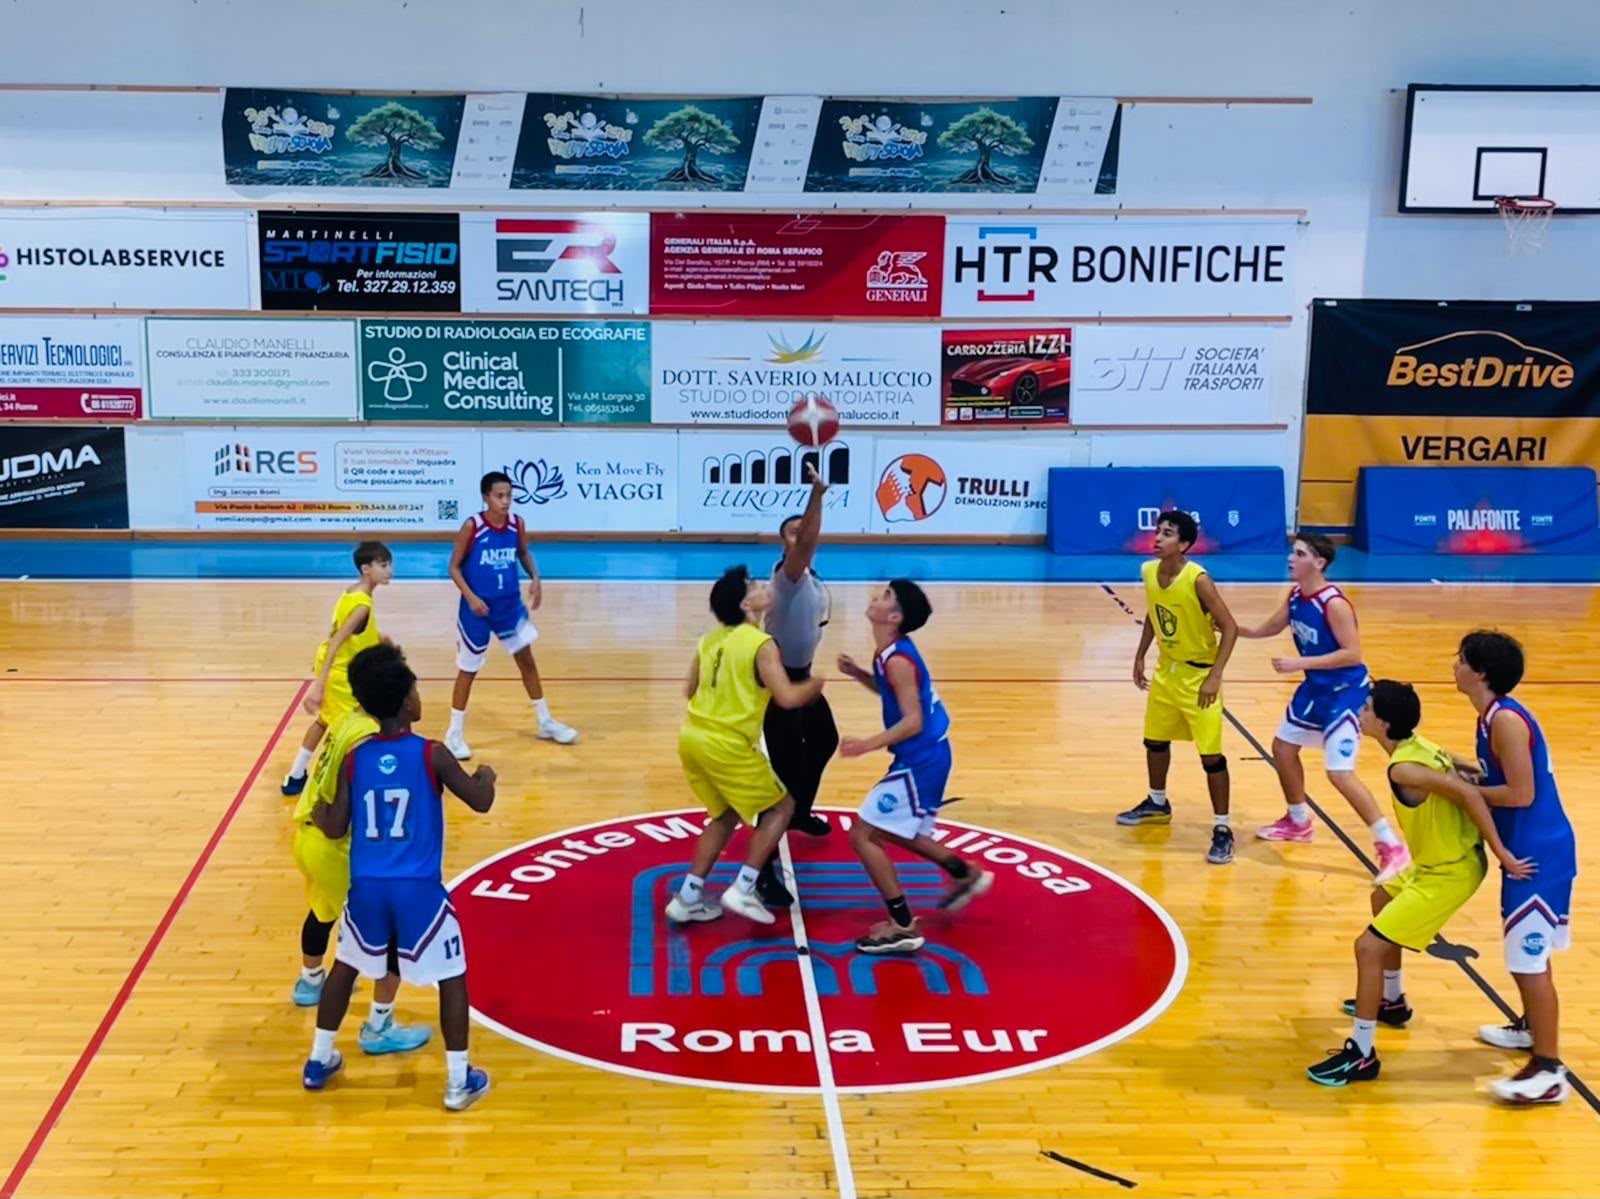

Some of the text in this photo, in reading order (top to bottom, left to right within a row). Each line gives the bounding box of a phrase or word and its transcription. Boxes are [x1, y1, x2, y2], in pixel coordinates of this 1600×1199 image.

[266, 230, 394, 240] MARTINELLI
[664, 238, 705, 246] GENERALI
[16, 248, 225, 268] HISTOLABSERVICE
[263, 241, 458, 265] SPORTFISIO
[356, 269, 437, 279] Per informazioni
[955, 246, 1285, 283] HTR BONIFICHE
[337, 279, 360, 293] Tel.
[363, 279, 457, 294] 327.29.12.359
[496, 279, 624, 301] SANTECH
[866, 289, 928, 302] GENERALI
[365, 326, 646, 341] STUDIO DI RADIOLOGIA ED ECOGRAFIE
[185, 337, 315, 350] CLAUDIO MANELLI
[947, 334, 1065, 355] CARROZZERIA IZZI
[0, 344, 39, 366] ERVIZI
[156, 350, 216, 358] CONSULENZA
[224, 351, 292, 359] PIANIFICAZIONE
[294, 351, 350, 359] FINANZIARIA
[443, 351, 518, 371] Clinical
[1195, 347, 1265, 361] SOCIETA'
[662, 370, 932, 388] DOTT. SAVERIO MALUCCIO
[1189, 363, 1257, 376] ITALIANA
[1386, 355, 1575, 388] BestDrive
[443, 371, 525, 391] Medical
[1183, 378, 1264, 391] TRASPORTI
[443, 391, 553, 415] Consulting
[679, 389, 914, 404] STUDIO DI ODONTOIATRIA
[1401, 435, 1547, 461] VERGARI
[256, 450, 318, 474] RES
[576, 463, 665, 477] Ken Move Fly
[398, 468, 425, 476] scopri
[370, 478, 413, 486] possiamo
[958, 477, 1030, 497] TRULLI
[577, 483, 663, 501] VIAGGI
[955, 496, 1047, 509] DEMOLIZIONI SPEC
[1448, 510, 1520, 531] PALAFONTE
[364, 789, 410, 838] 17
[470, 830, 636, 902] Fonte
[444, 935, 461, 959] 17
[620, 1022, 1048, 1053] Roma Eur
